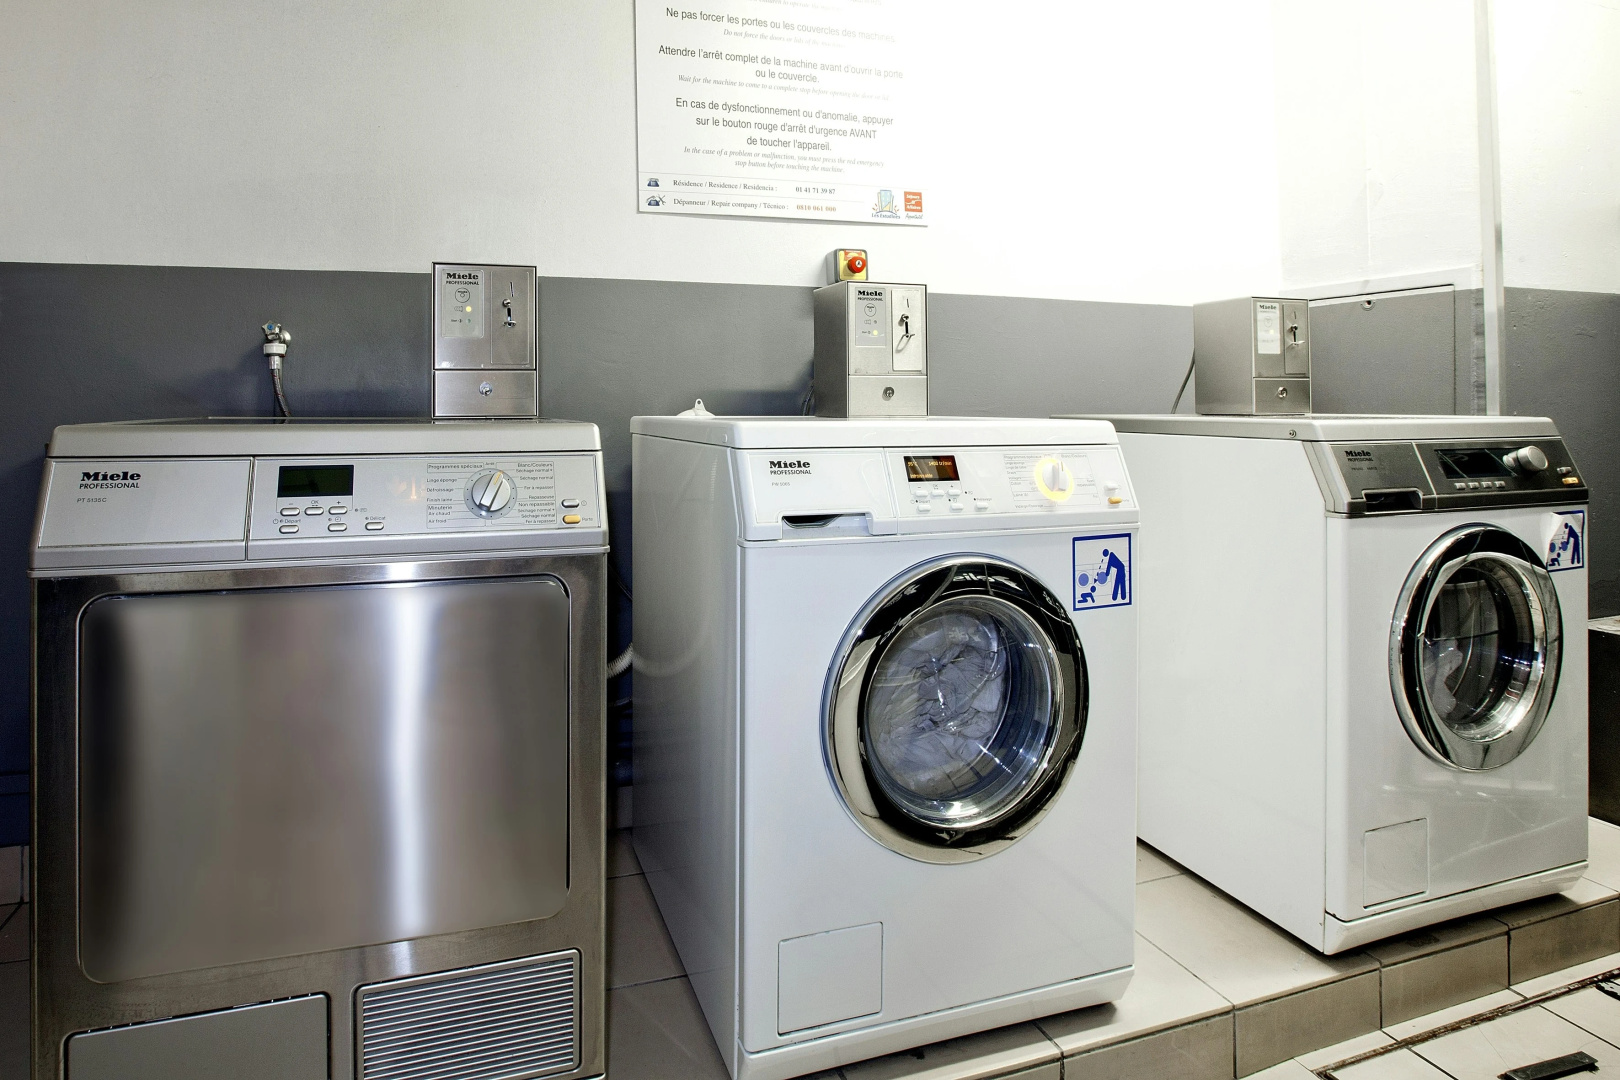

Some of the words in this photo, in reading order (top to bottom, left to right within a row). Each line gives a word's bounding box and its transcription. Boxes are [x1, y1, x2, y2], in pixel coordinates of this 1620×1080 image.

[666, 8, 678, 18] Ne
[682, 10, 697, 20] pas
[700, 11, 724, 22] forcer
[727, 14, 740, 24] les
[742, 18, 768, 27] portes
[770, 20, 780, 29] ou
[783, 20, 795, 30] les
[797, 24, 840, 36] couvercles
[842, 28, 856, 38] des
[659, 45, 696, 57] Attendre
[698, 48, 723, 60] l'arrêt
[725, 54, 758, 64] complet
[761, 56, 771, 65] de
[774, 57, 781, 66] la
[784, 59, 818, 70] machine
[820, 64, 842, 72] avant
[844, 65, 872, 75] d'ouvrir
[874, 68, 882, 76] la
[884, 70, 903, 79] porte
[756, 70, 766, 78] ou
[768, 69, 775, 78] le
[778, 72, 820, 82] couvercle.
[692, 76, 701, 84] for
[812, 87, 829, 95] before
[676, 97, 688, 107] En
[690, 100, 706, 109] cas
[708, 100, 719, 110] de
[722, 102, 801, 117] dysfonctionnement
[815, 110, 860, 123] d'anomalie,
[862, 115, 894, 126] appuyer
[696, 117, 710, 126] sur
[712, 117, 720, 126] le
[722, 118, 752, 129] bouton
[754, 122, 778, 133] rouge
[780, 123, 806, 133] d'arrêt
[808, 125, 847, 137] d'urgence
[849, 129, 877, 139] AVANT
[746, 136, 758, 145] de
[760, 137, 791, 148] toucher
[793, 139, 832, 151] l'appareil.
[716, 149, 724, 157] of
[767, 161, 785, 169] before
[786, 164, 810, 172] touching
[81, 471, 141, 481] Miele
